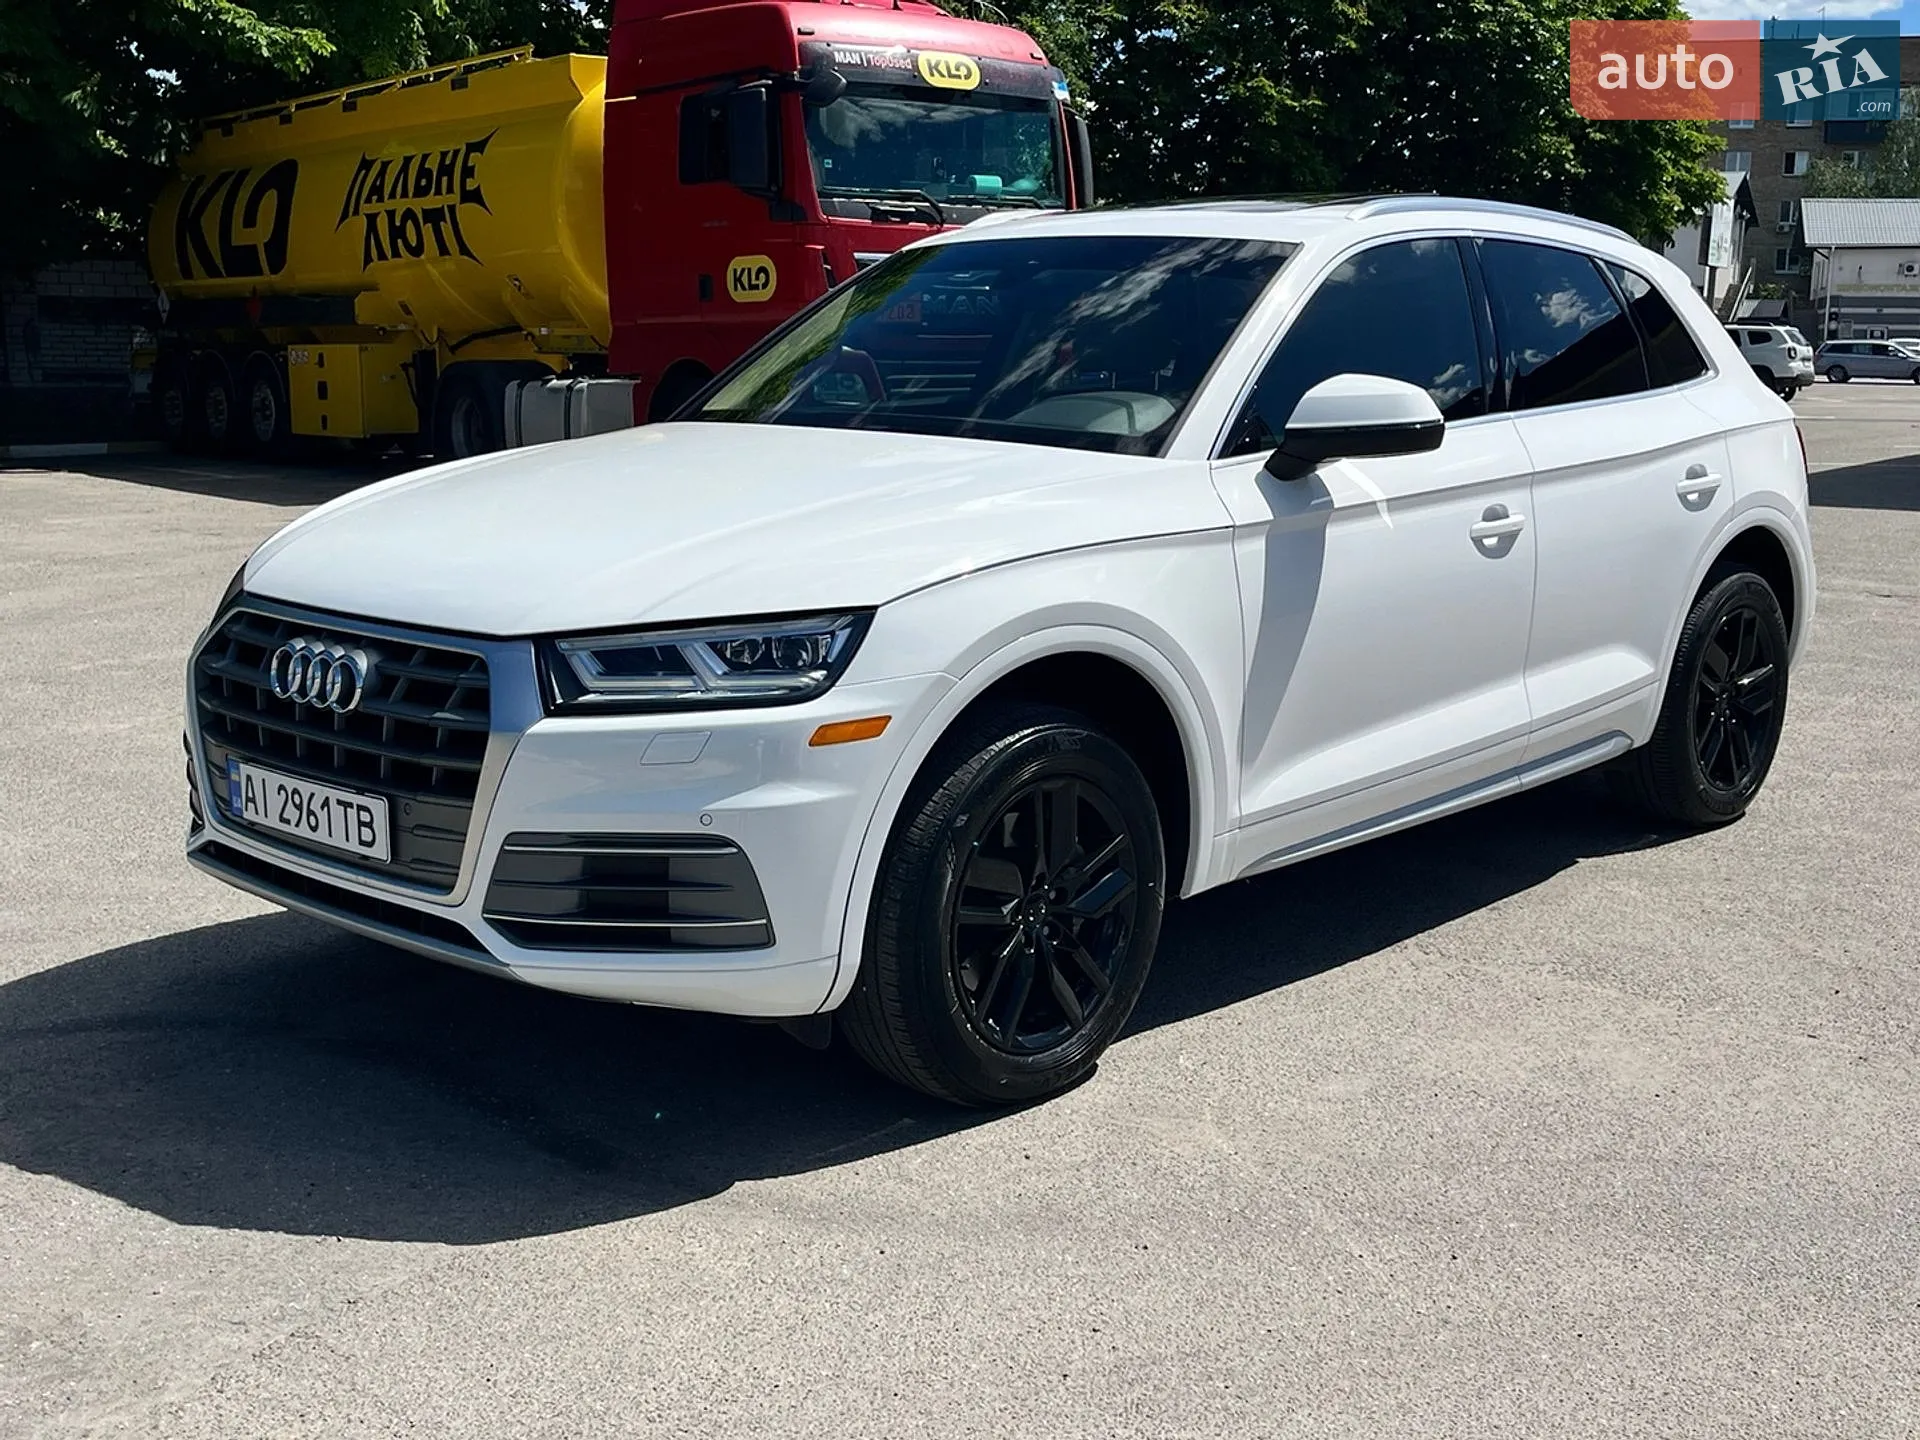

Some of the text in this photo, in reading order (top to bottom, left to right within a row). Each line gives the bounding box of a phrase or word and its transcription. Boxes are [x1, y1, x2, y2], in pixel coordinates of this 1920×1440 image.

[833, 51, 913, 69] MAN TopUsed
[925, 58, 973, 81] KLO
[334, 127, 500, 233] ПАЛЬНЕ
[174, 157, 300, 280] KLO
[732, 265, 771, 292] KLO
[922, 293, 999, 315] MAN
[244, 773, 268, 819] AI
